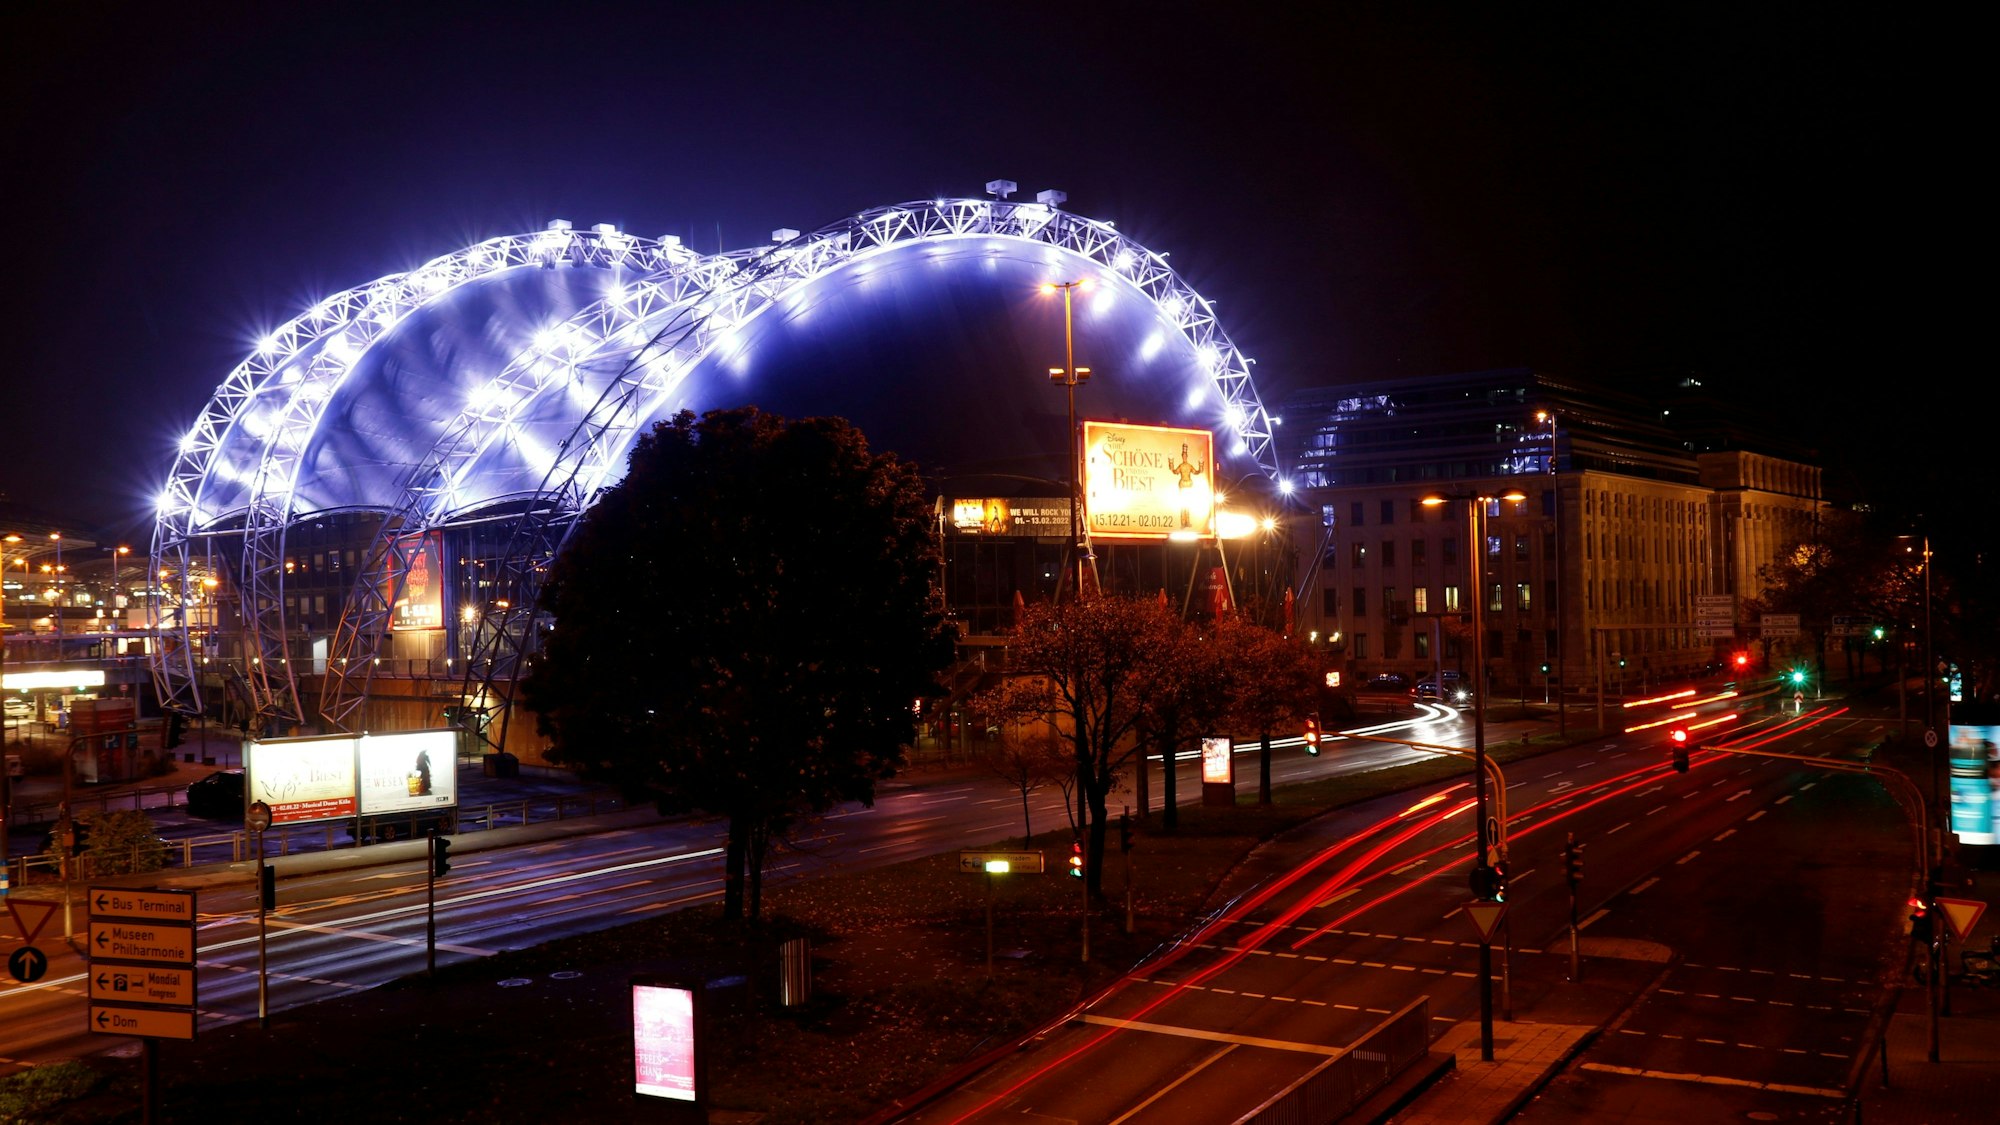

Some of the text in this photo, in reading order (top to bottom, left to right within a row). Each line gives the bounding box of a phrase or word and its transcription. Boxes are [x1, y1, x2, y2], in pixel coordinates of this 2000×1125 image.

[1105, 431, 1125, 445] Disney
[1102, 443, 1163, 469] SCHÖNE
[1113, 467, 1155, 491] BIEST
[1010, 508, 1021, 516] WE
[1022, 508, 1039, 516] WILL
[1041, 508, 1058, 516] ROCK
[1095, 514, 1130, 526] 15.12.21
[1138, 515, 1173, 527] 02.01.22
[302, 800, 322, 809] Musical
[323, 799, 338, 807] Dome
[112, 897, 185, 913] Bus Terminal
[112, 927, 154, 941] Museen
[112, 942, 185, 958] Philharmonie
[148, 972, 181, 985] Mondial
[148, 988, 176, 999] Kongress
[113, 1014, 137, 1028] Dom
